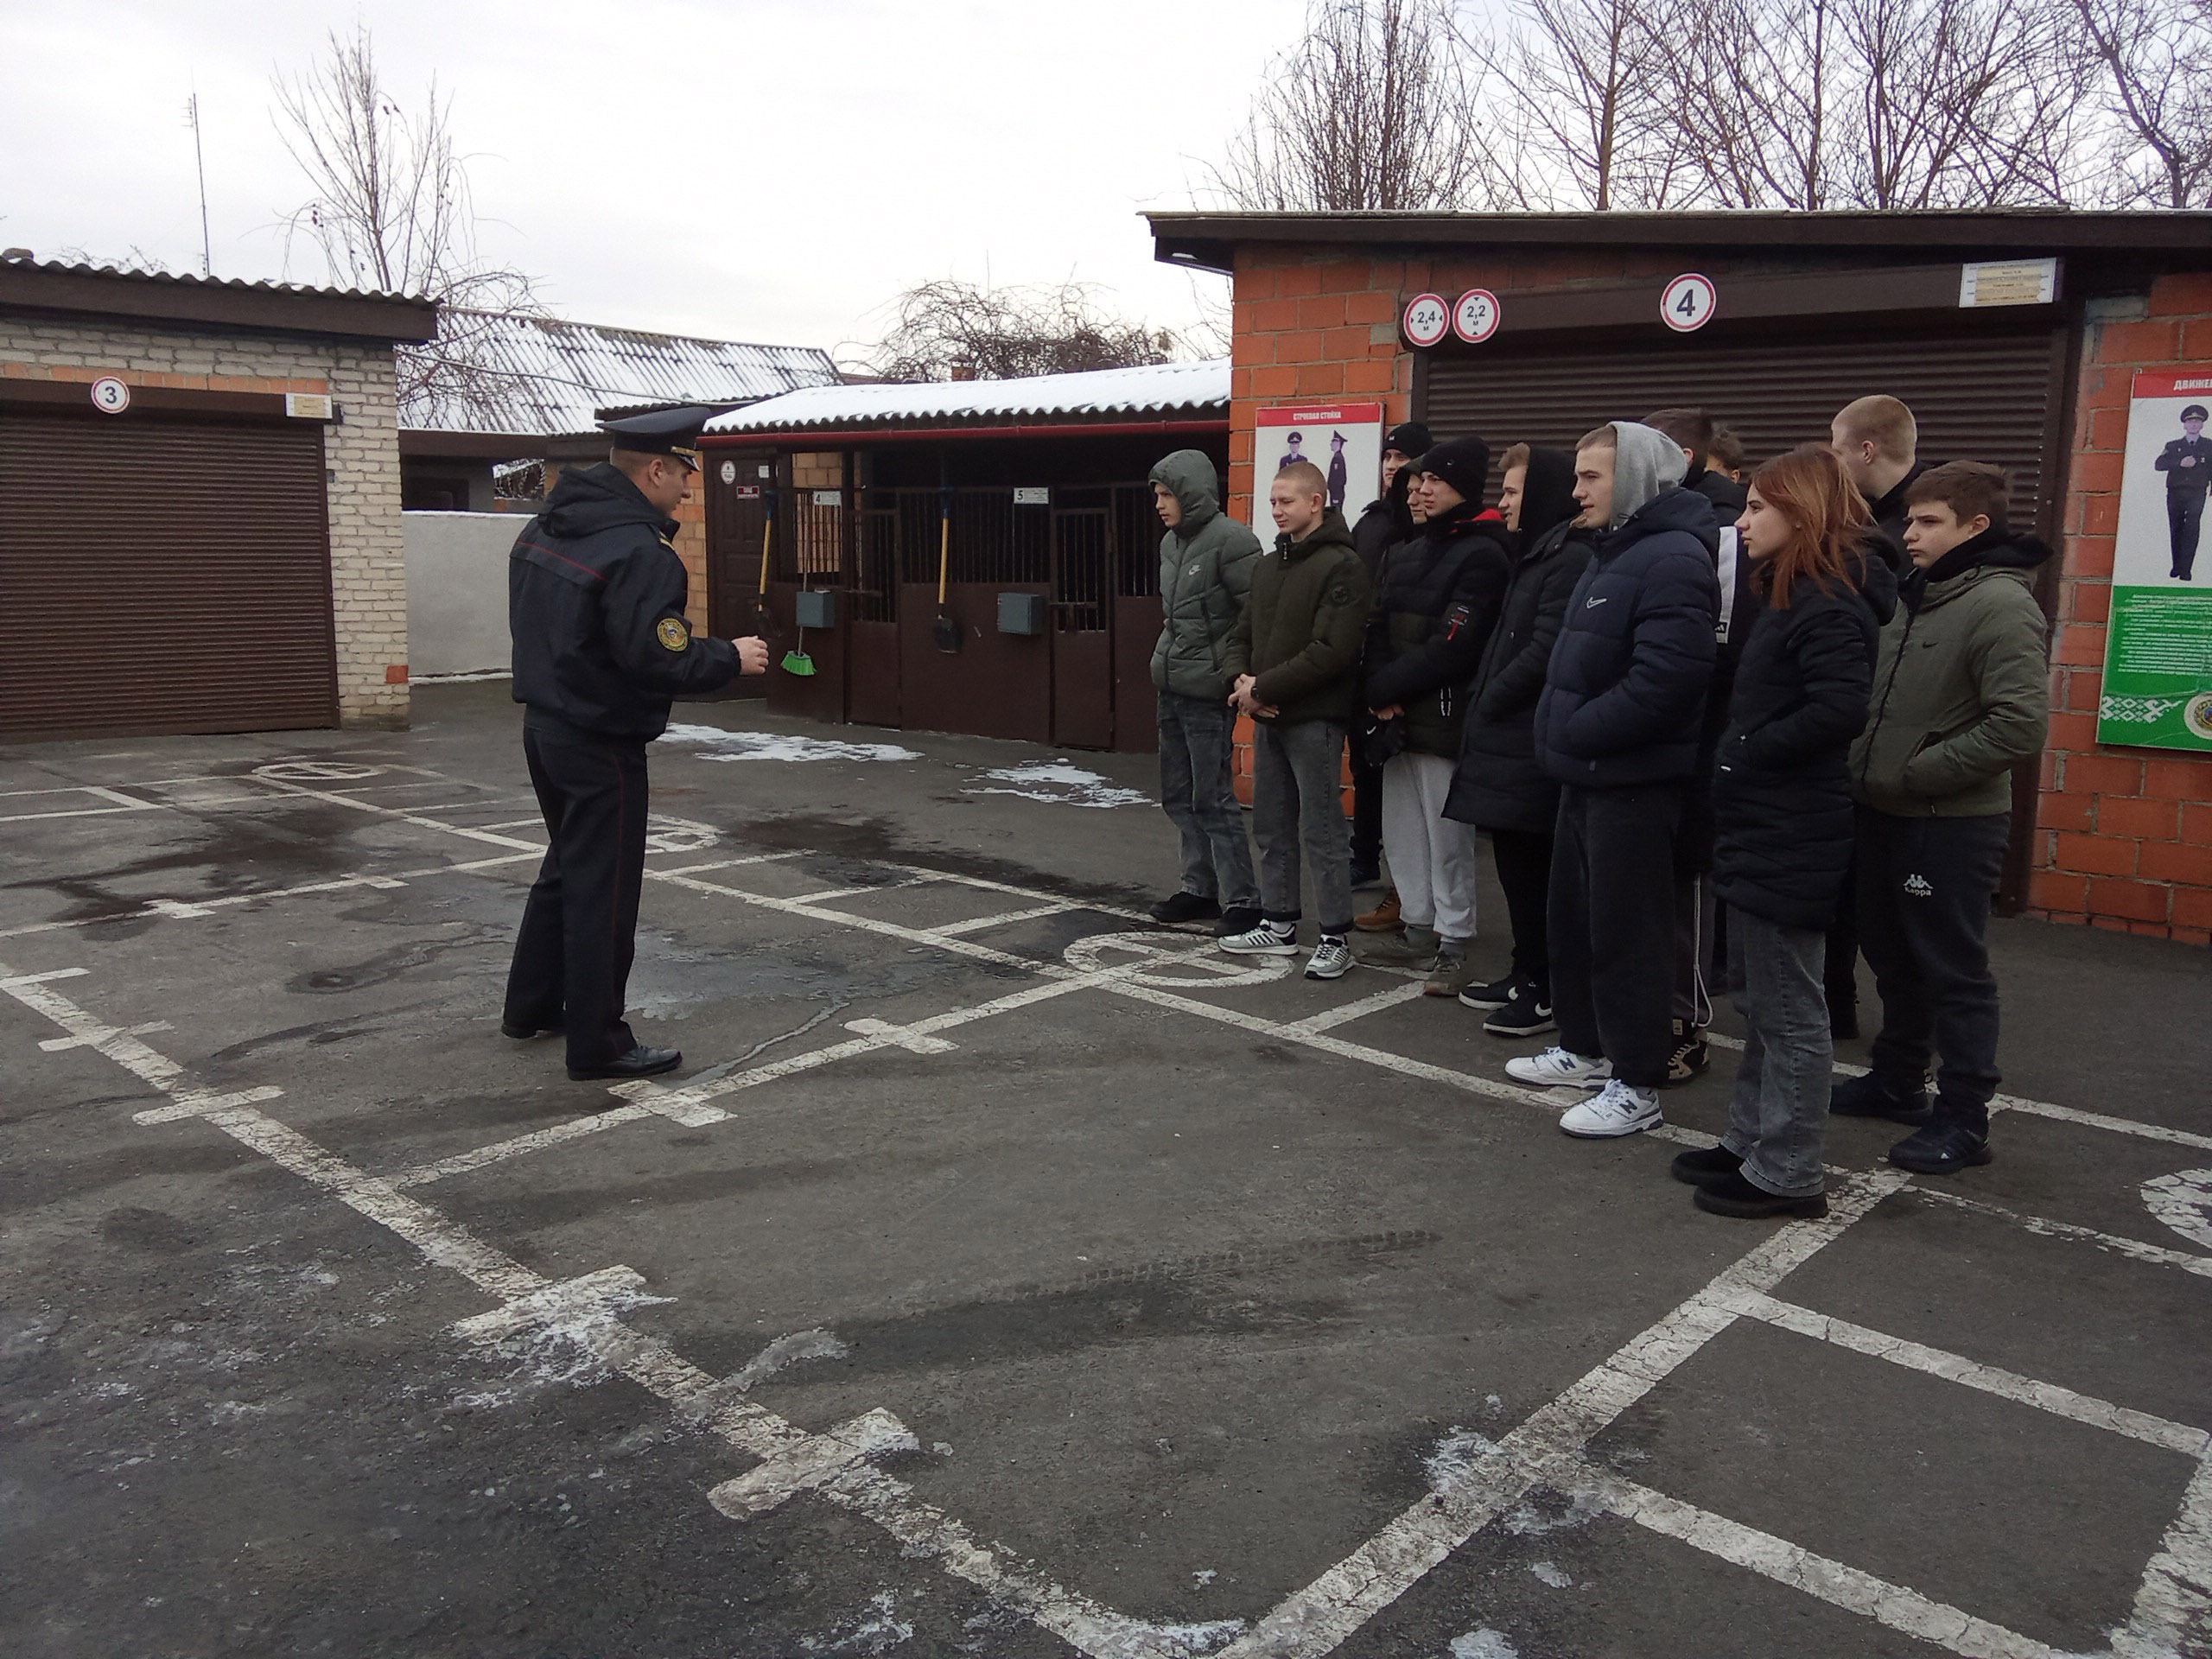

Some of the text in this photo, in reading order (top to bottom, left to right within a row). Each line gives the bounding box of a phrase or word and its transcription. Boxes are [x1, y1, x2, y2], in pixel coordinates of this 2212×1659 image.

[1676, 289, 1695, 316] 4
[1417, 310, 1436, 324] 2,4
[1466, 305, 1486, 319] 2,2
[105, 385, 118, 404] 3
[815, 493, 821, 503] 4
[1017, 489, 1024, 500] 5
[1904, 887, 1932, 897] Kappa
